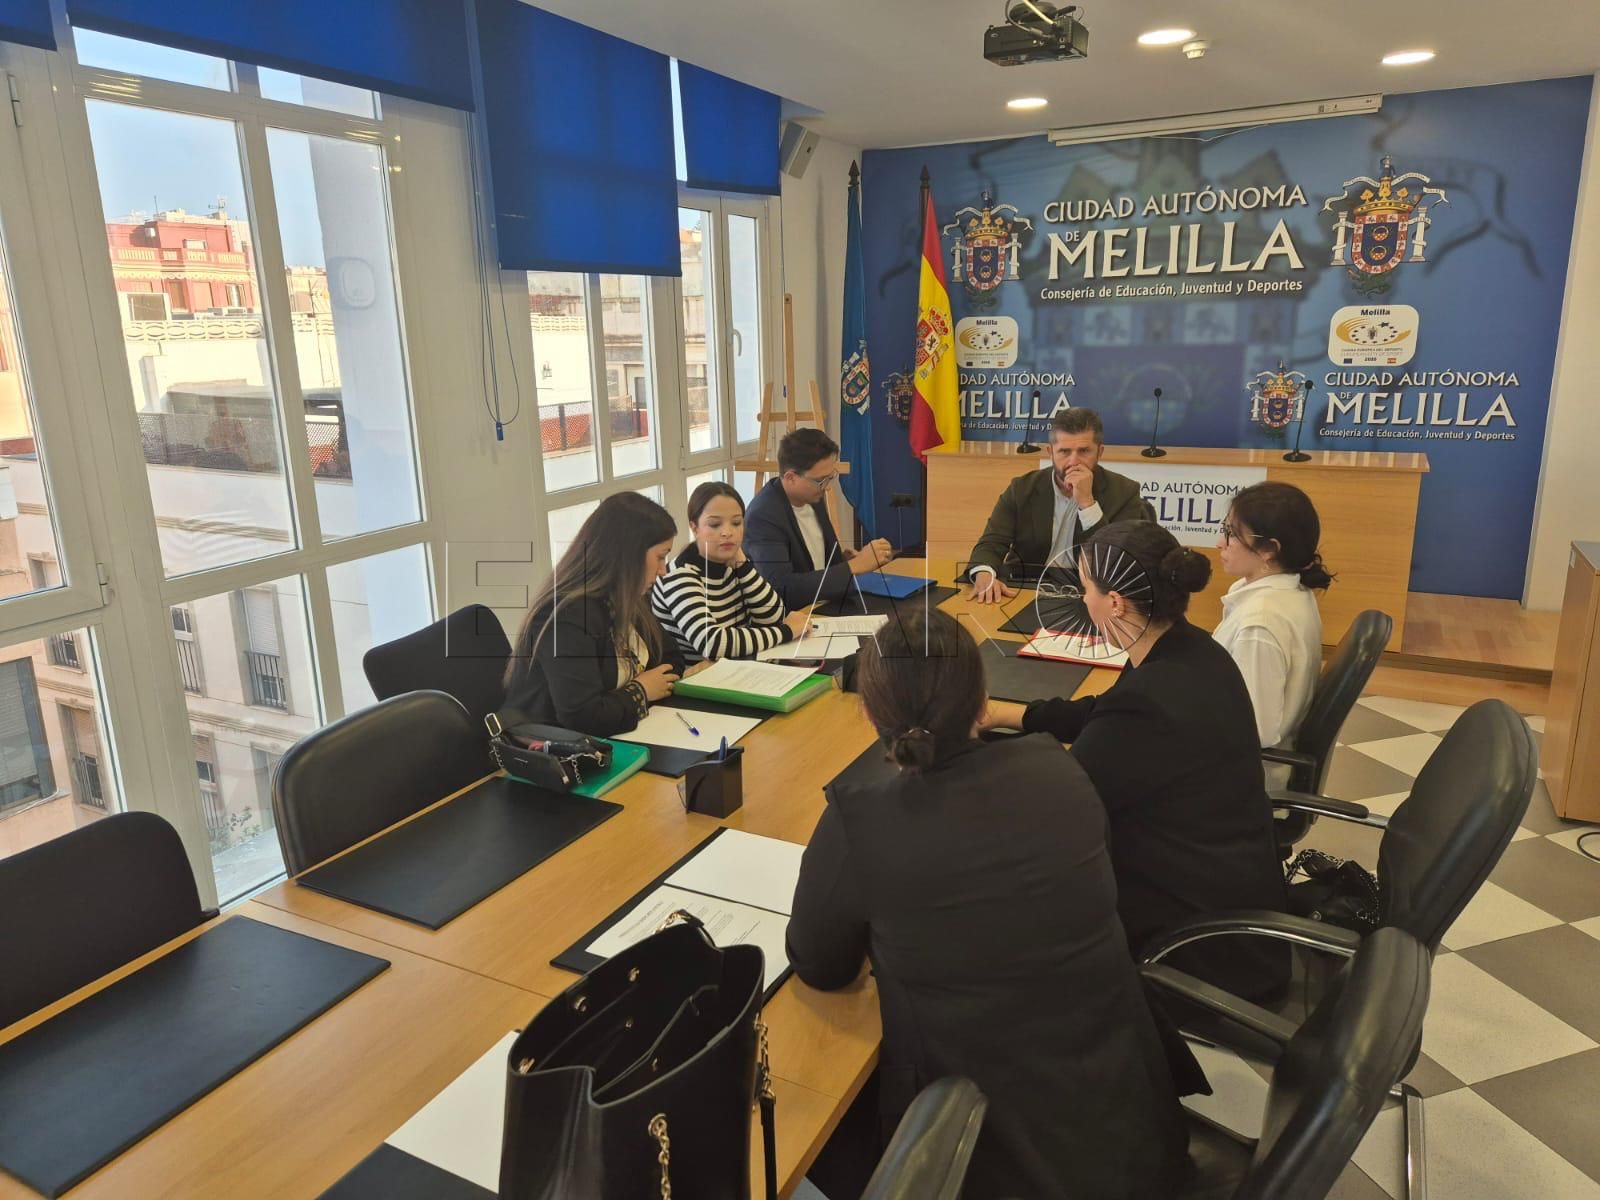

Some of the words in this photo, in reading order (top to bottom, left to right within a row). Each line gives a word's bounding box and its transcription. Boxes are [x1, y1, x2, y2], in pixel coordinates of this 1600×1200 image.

[1043, 197, 1135, 223] CIUDAD
[1141, 184, 1308, 217] AUTÓNOMA
[1065, 231, 1080, 242] DE
[1047, 218, 1305, 280] MELILLA
[1040, 286, 1095, 301] Consejería
[1099, 284, 1112, 298] de
[1116, 283, 1177, 298] Educación,
[1180, 280, 1232, 296] Juventud
[1235, 283, 1243, 295] y
[1247, 279, 1303, 295] Deportes
[1360, 308, 1391, 316] Melilla
[960, 373, 986, 385] DAD
[991, 371, 1075, 386] AUTÓNOMA
[1324, 371, 1394, 387] CIUDAD
[1398, 369, 1520, 388] AUTÓNOMA
[1326, 391, 1517, 427] MELILLA
[1319, 427, 1362, 439] Consejería
[1364, 428, 1374, 438] de
[1376, 428, 1423, 440] Educación,
[1425, 429, 1464, 441] Juventud
[1465, 431, 1472, 442] y
[1474, 430, 1515, 442] Deportes
[1163, 481, 1246, 495] AUTÓNOM
